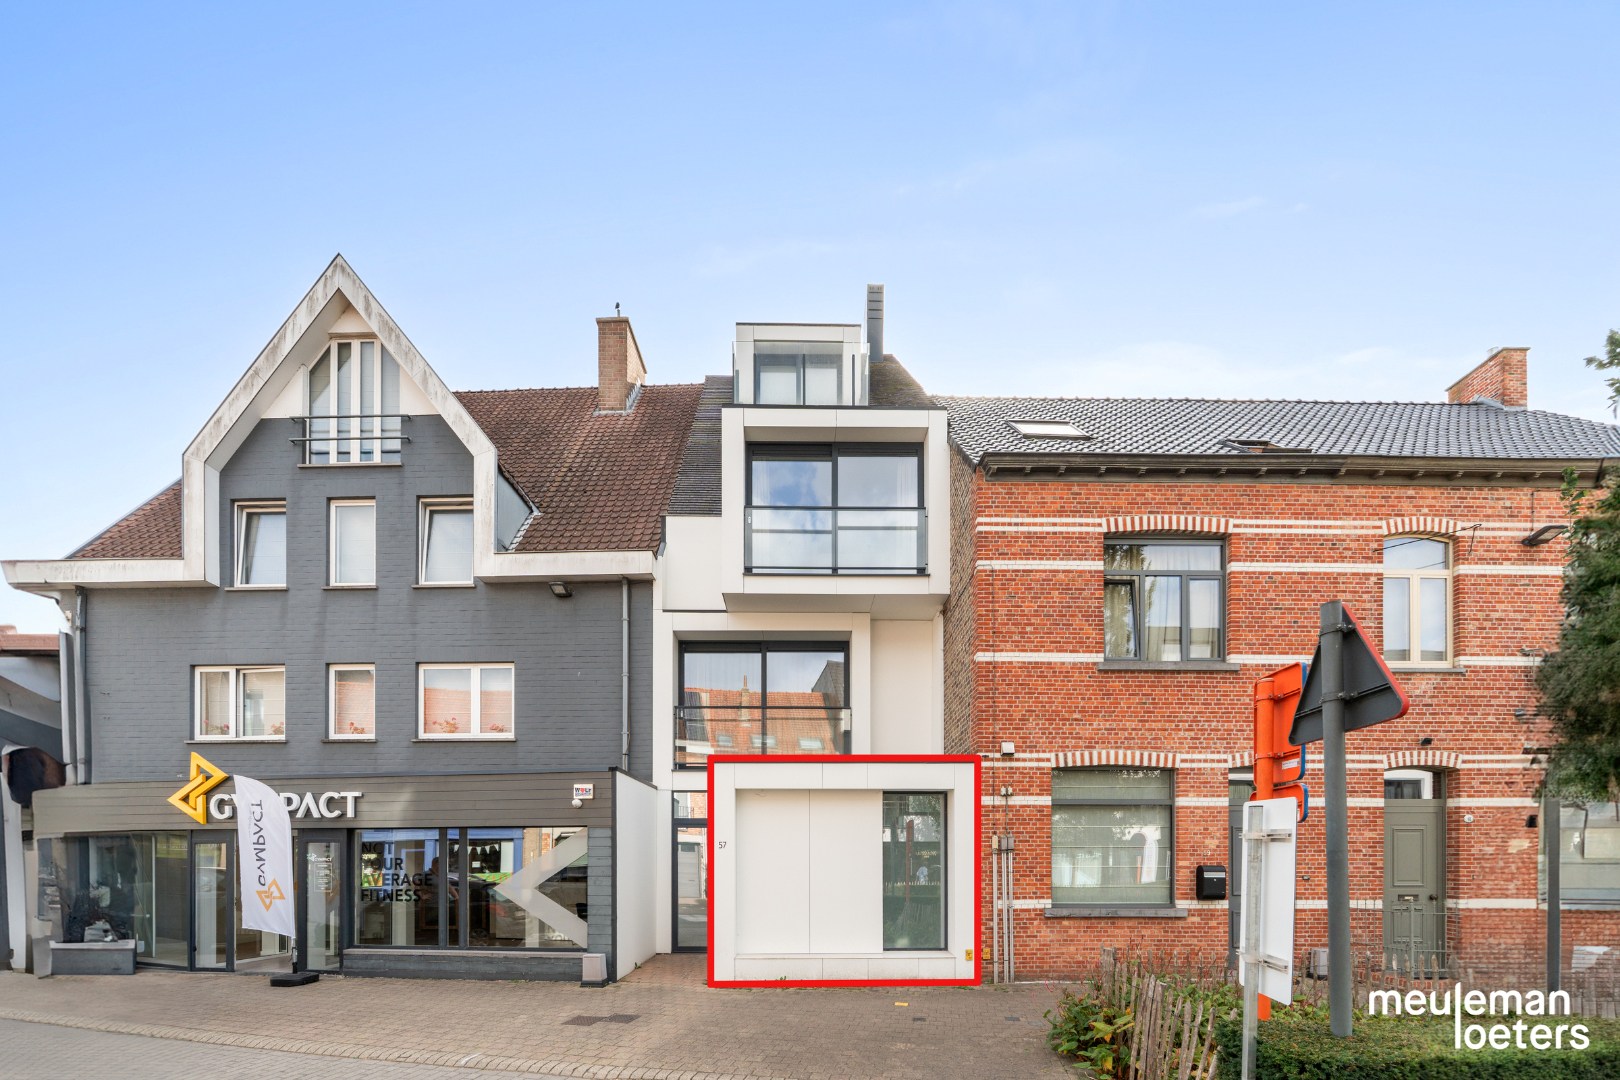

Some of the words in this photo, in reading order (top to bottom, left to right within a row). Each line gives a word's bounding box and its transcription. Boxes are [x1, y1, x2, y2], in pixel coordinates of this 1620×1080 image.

[209, 791, 362, 819] GPACT
[718, 841, 727, 849] 57
[361, 857, 404, 871] OUR
[361, 888, 421, 902] FITNESS
